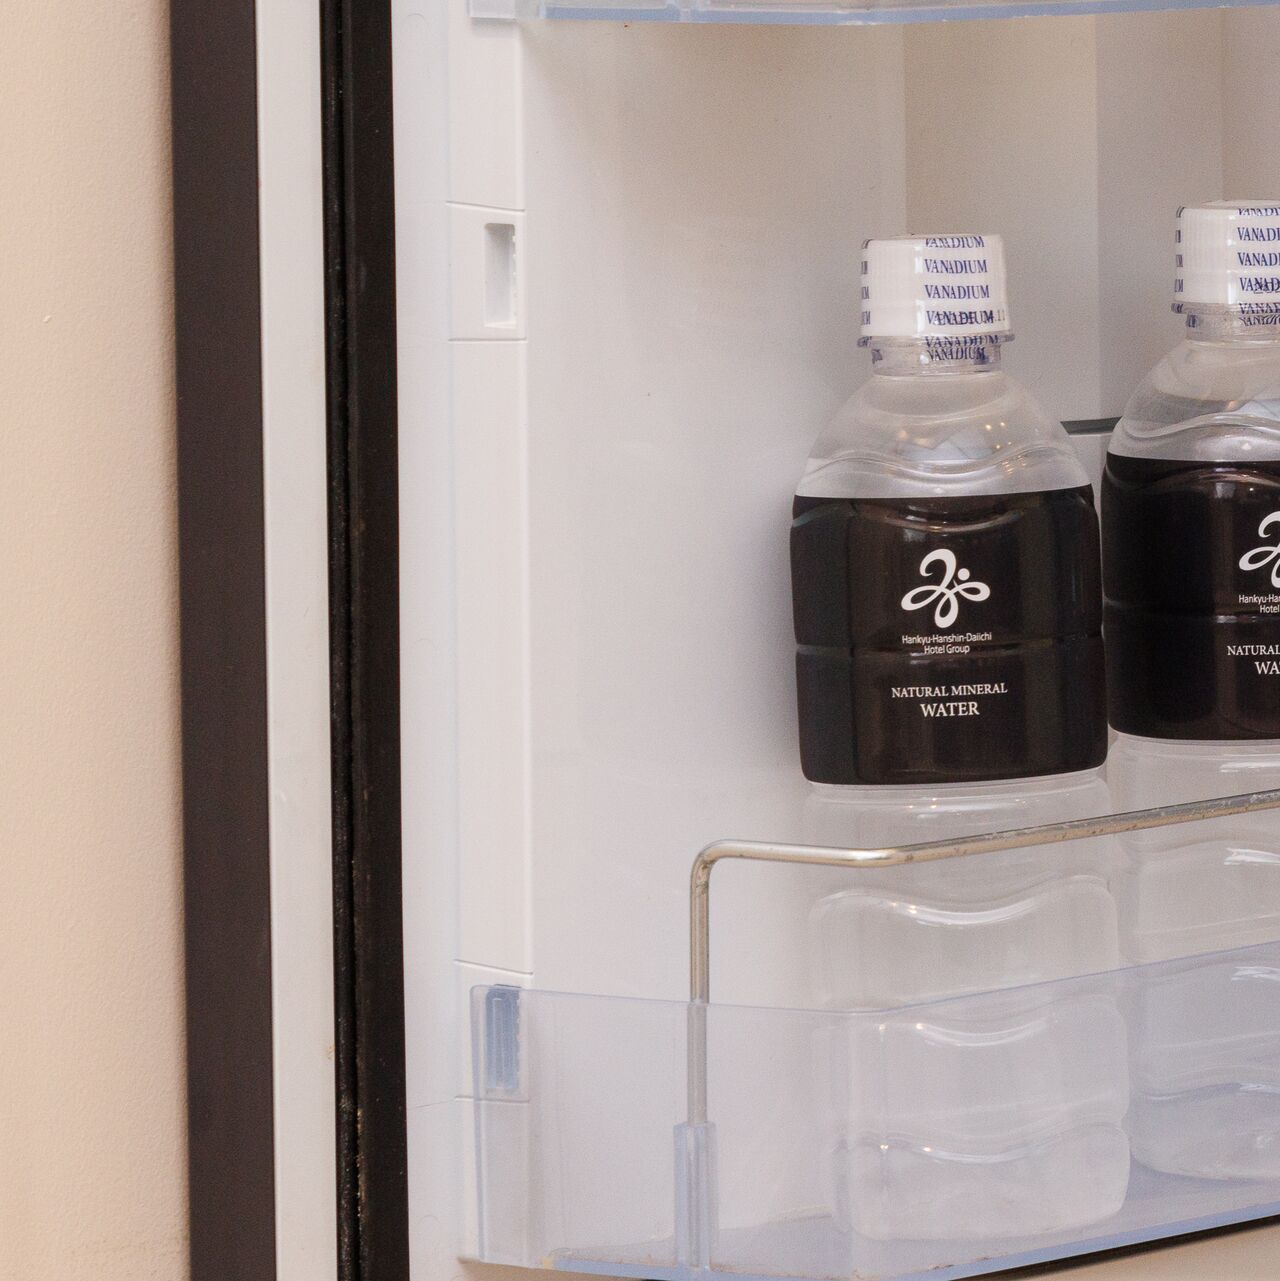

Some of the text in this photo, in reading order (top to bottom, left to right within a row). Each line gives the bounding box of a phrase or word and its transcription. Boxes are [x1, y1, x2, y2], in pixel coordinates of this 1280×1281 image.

[925, 258, 988, 275] VANADIUM
[925, 284, 990, 299] VANADIUM
[1260, 604, 1280, 614] Hotel
[902, 632, 992, 645] Hankyu-Hanshin-Daiichi
[924, 645, 970, 655] Hotel Group
[892, 683, 1008, 698] NATURAL MINERAL
[921, 701, 980, 717] WATER
